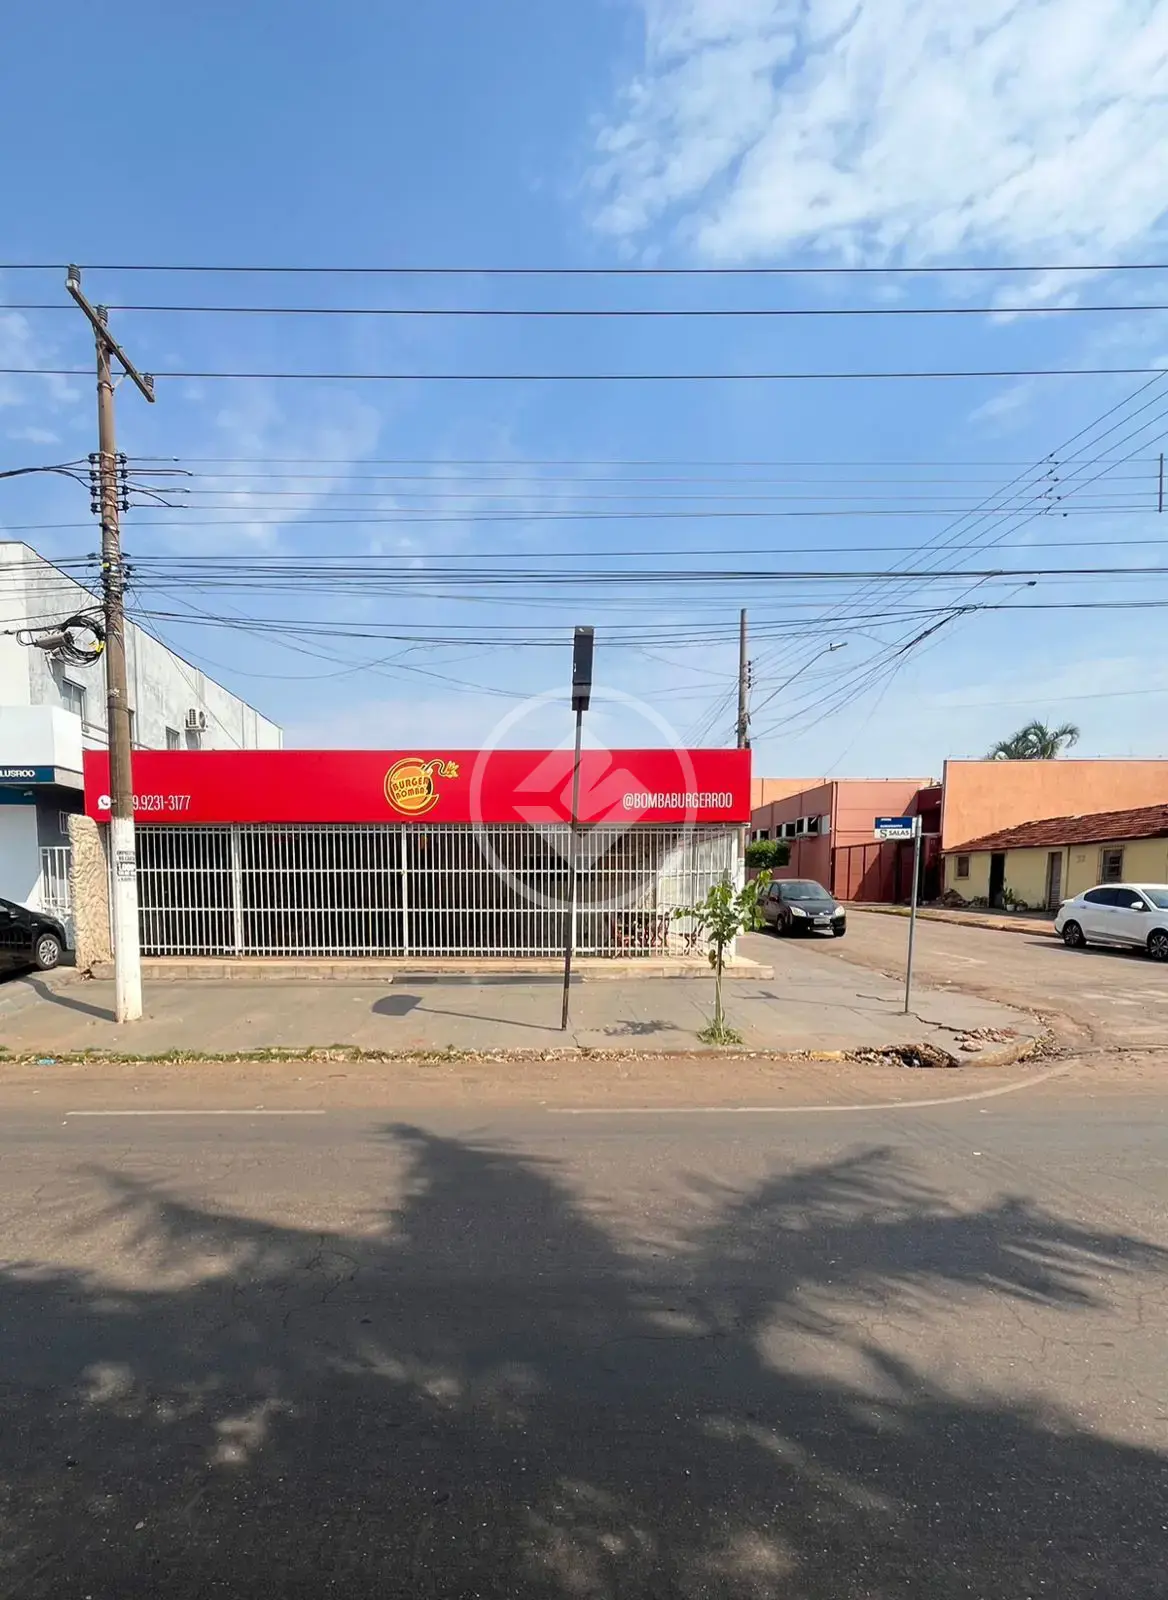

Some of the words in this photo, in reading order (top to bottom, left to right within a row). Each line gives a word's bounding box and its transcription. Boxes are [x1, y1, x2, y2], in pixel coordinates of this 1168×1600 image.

[391, 776, 429, 791] BURGER
[395, 786, 425, 799] BOMBA
[622, 792, 733, 810] @BOMBABURGERROO
